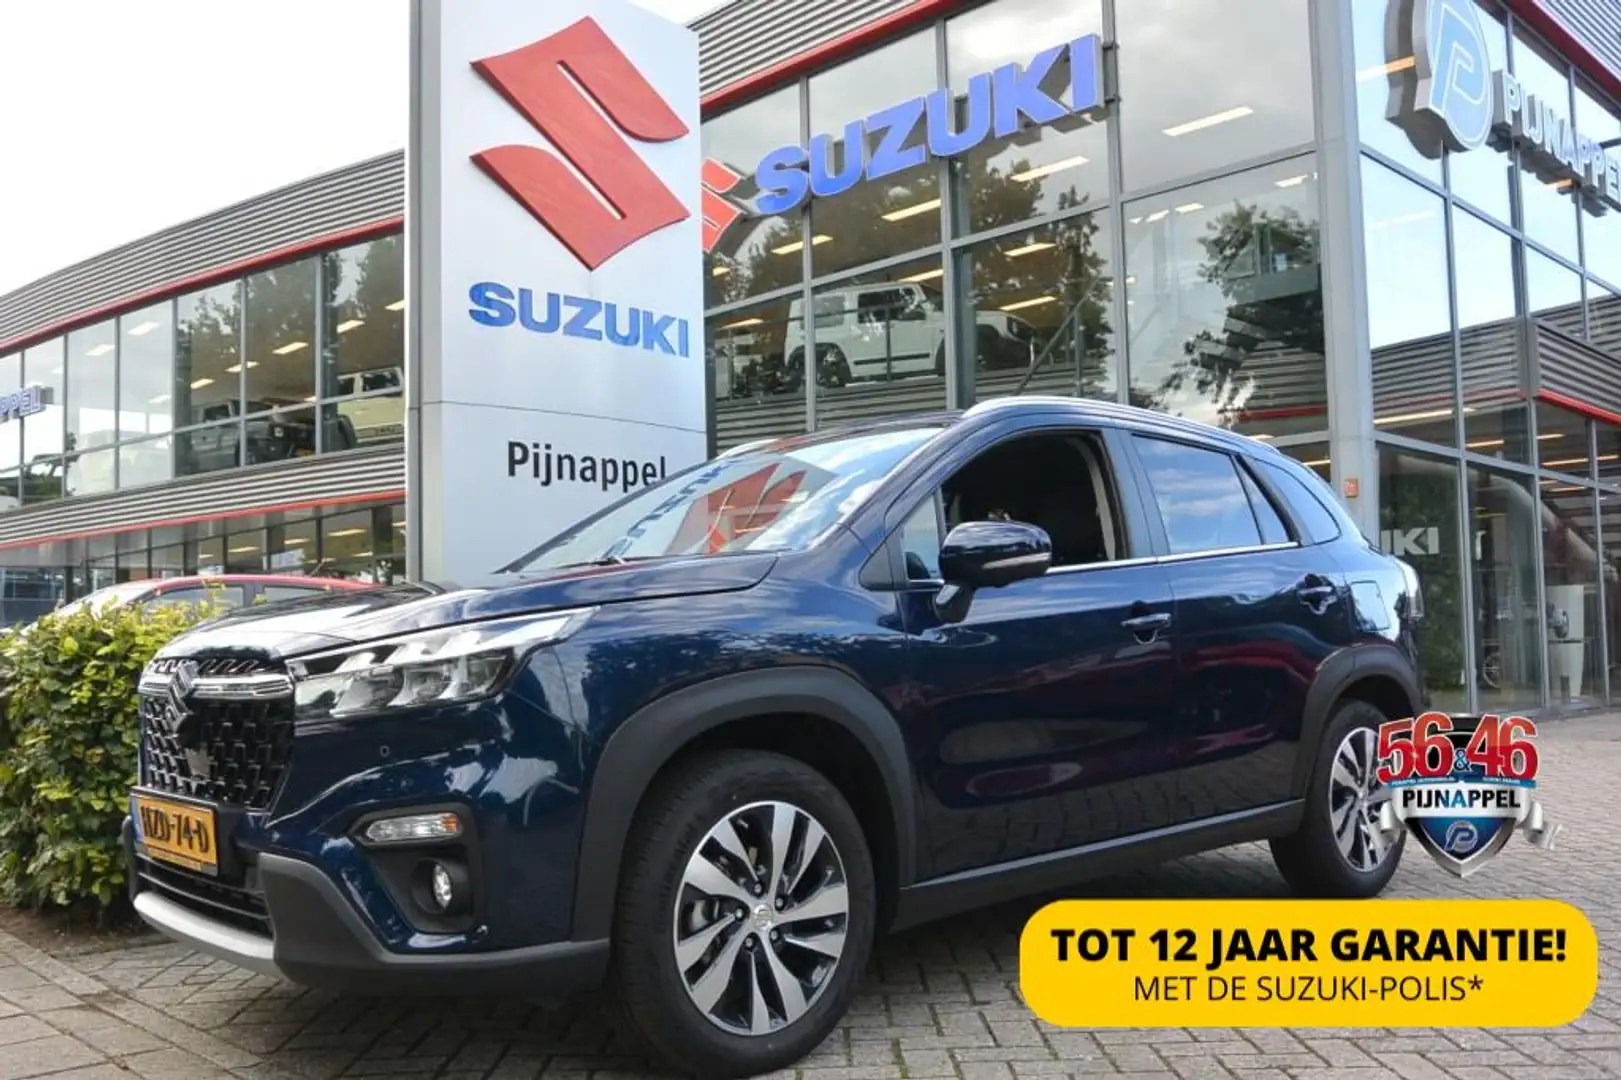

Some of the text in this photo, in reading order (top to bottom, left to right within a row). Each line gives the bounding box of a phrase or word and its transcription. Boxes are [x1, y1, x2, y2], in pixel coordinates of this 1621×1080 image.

[755, 33, 1105, 215] SUZUKI
[468, 281, 690, 358] SUZUKI
[507, 440, 666, 493] Pijnappel
